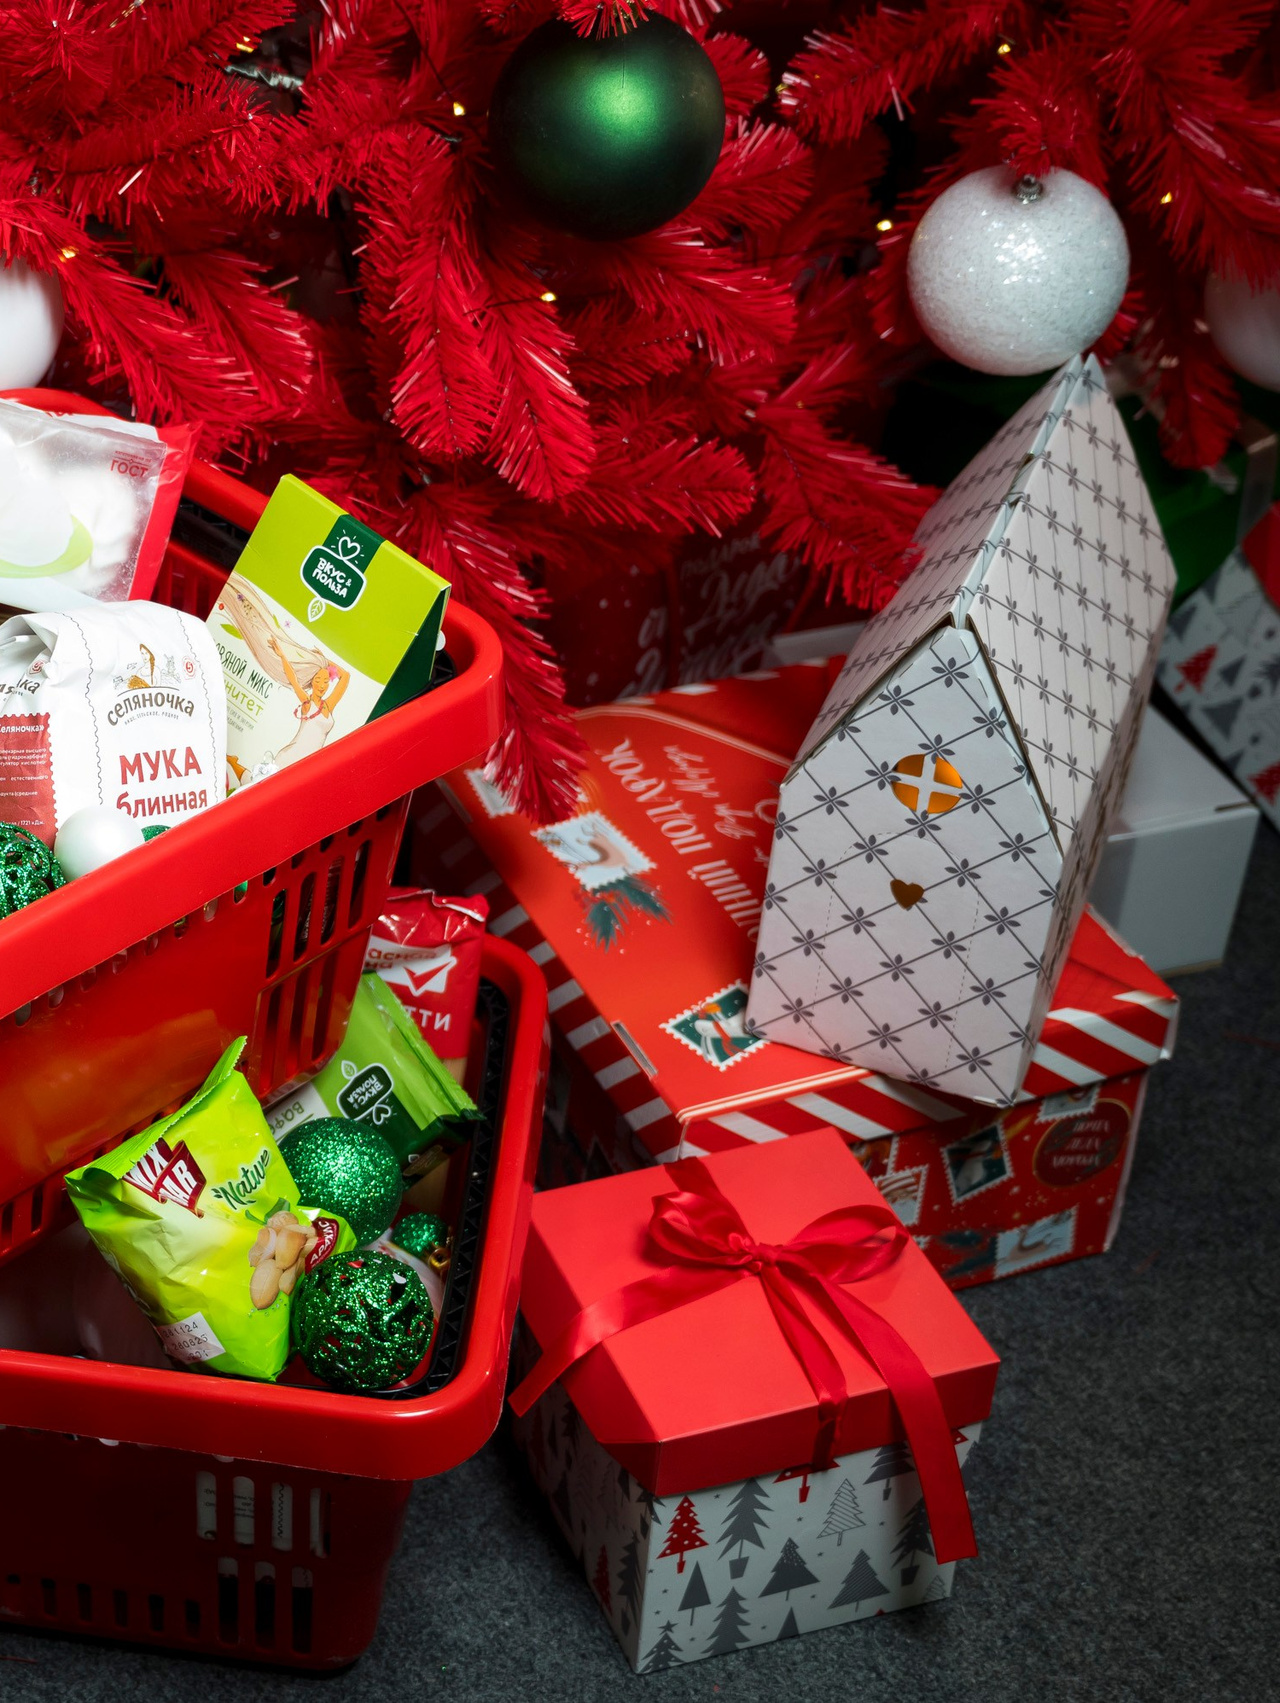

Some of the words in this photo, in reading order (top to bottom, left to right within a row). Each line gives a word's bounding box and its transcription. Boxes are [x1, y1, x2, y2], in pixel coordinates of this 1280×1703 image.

[110, 458, 149, 477] ГОСТ
[312, 568, 348, 598] ПОЛЬЗА
[317, 557, 347, 582] ВКУС
[247, 668, 274, 699] МИКС
[107, 692, 195, 727] селяночка
[119, 746, 202, 785] МУКА
[116, 789, 208, 819] блинная
[596, 738, 713, 855] ПОДАРОК
[368, 948, 438, 960] асная
[346, 1073, 378, 1104] ПОЛЬЗА
[358, 1082, 384, 1110] ВКУС
[218, 1148, 271, 1211] Nature
[162, 1321, 199, 1339] 281124
[172, 1333, 209, 1351] 280825
